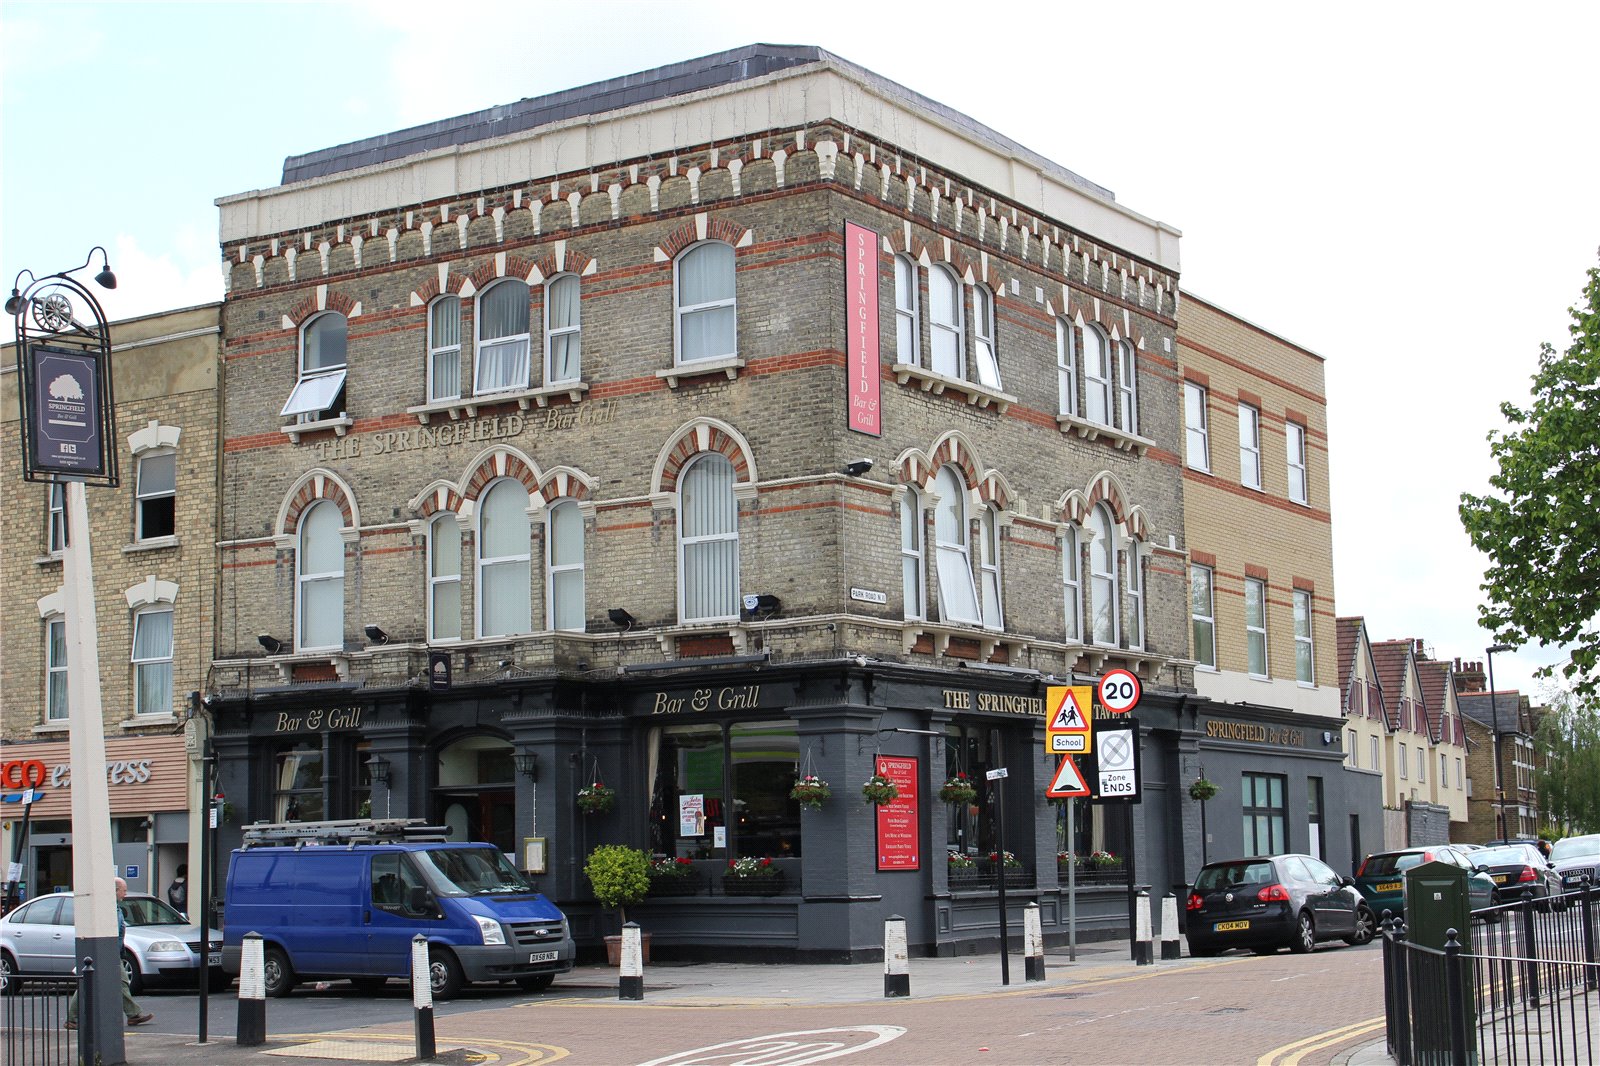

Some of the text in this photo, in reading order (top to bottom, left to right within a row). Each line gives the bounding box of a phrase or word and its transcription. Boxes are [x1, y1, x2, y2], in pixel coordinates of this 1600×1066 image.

[858, 233, 869, 394] SPRINGFIELD
[48, 402, 86, 412] SPRINGFIELD
[853, 394, 877, 411] Bar &
[857, 412, 874, 427] Grill
[316, 436, 361, 462] THE
[374, 414, 524, 456] SPRINGFIELD
[545, 408, 573, 432] Bar
[651, 685, 760, 715] Bar & Grill
[1105, 682, 1133, 700] 20
[943, 690, 970, 709] THE
[978, 693, 1046, 716] SPRINGFIEL
[275, 707, 361, 732] Bar & Grill
[1207, 720, 1266, 742] SPRINGFIELD
[1269, 727, 1280, 744] Bar
[1056, 738, 1082, 747] School
[0, 758, 46, 789] CO
[1107, 774, 1126, 782] Zone
[1103, 783, 1132, 793] ENDS
[1217, 922, 1233, 931] CK04
